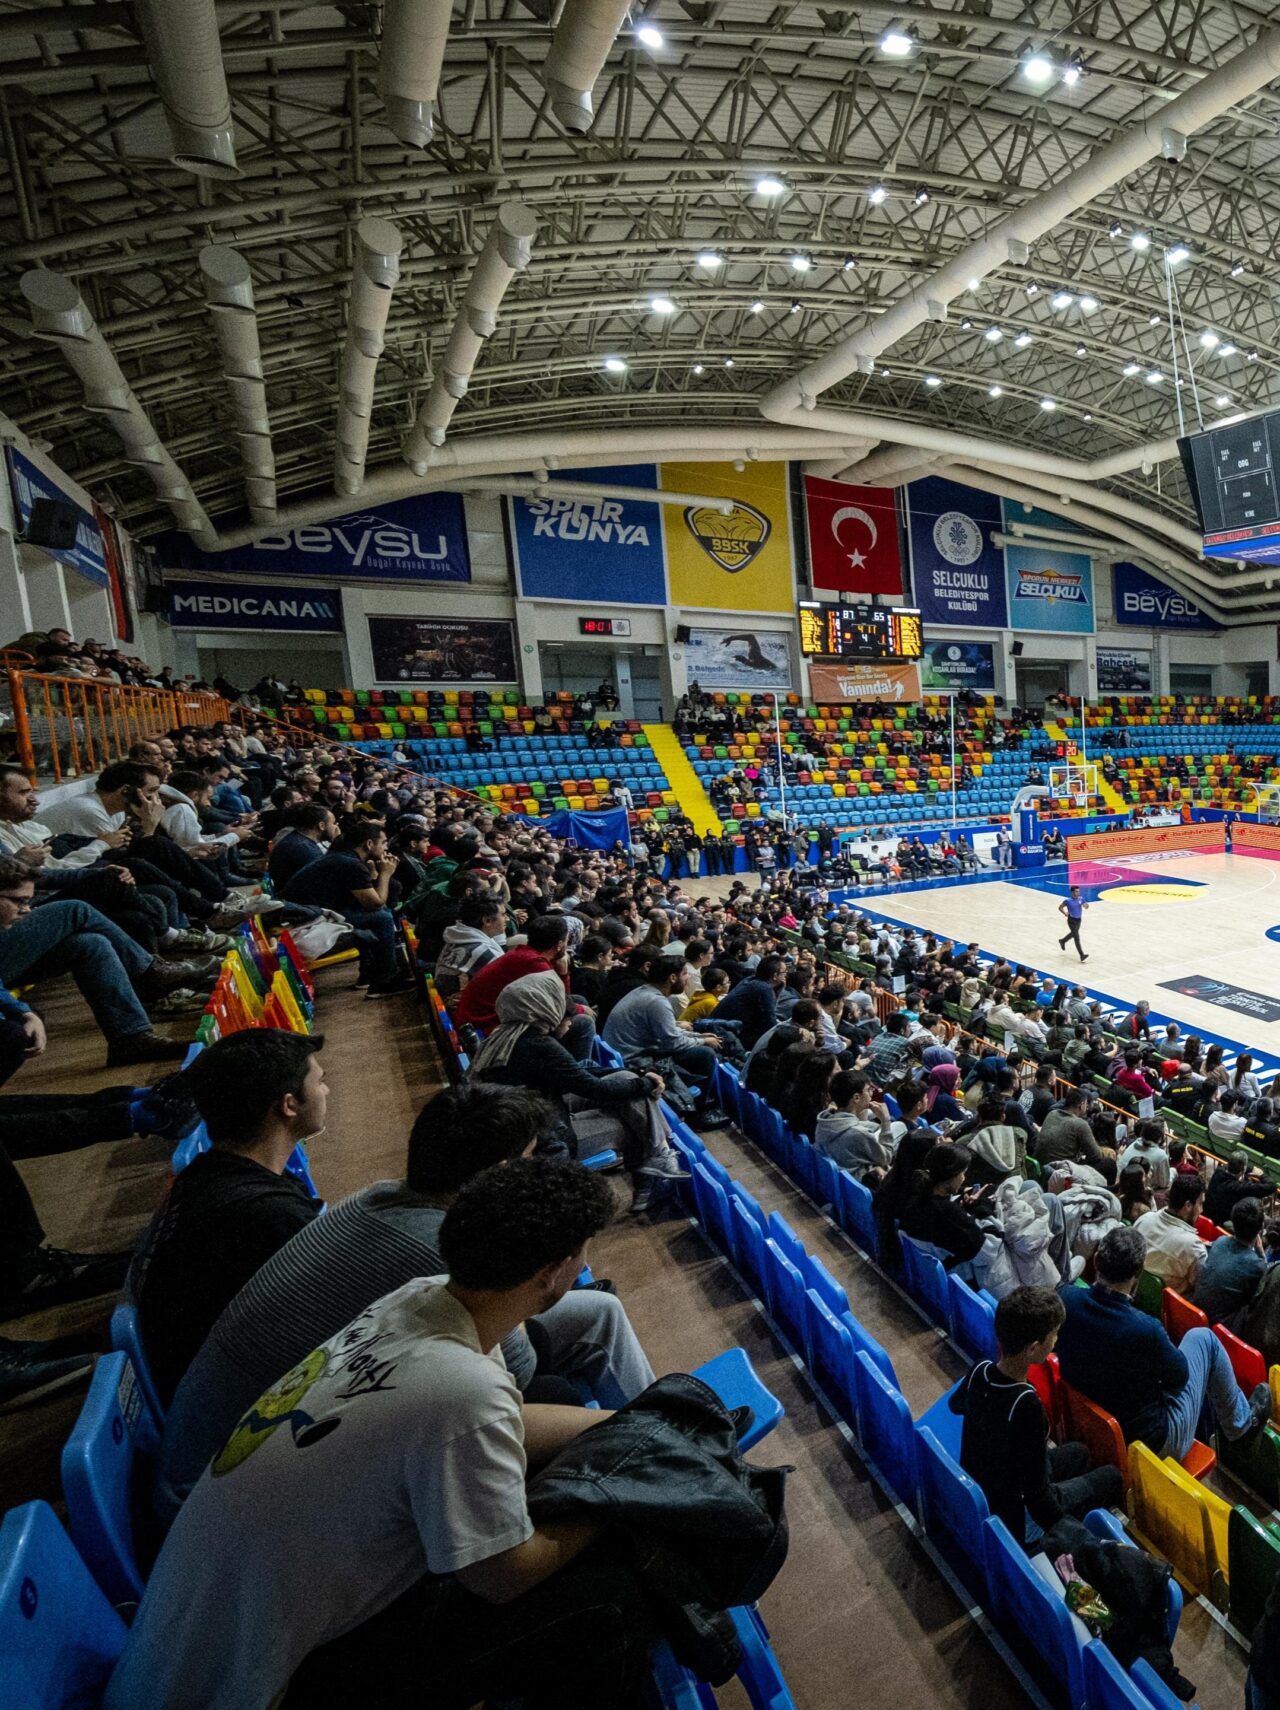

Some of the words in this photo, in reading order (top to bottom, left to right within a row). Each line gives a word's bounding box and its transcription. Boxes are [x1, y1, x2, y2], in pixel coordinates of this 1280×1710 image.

[932, 570, 988, 590] SELÇUKLU
[934, 588, 990, 601] BELEDİYESPOR
[174, 595, 320, 618] MEDICANA
